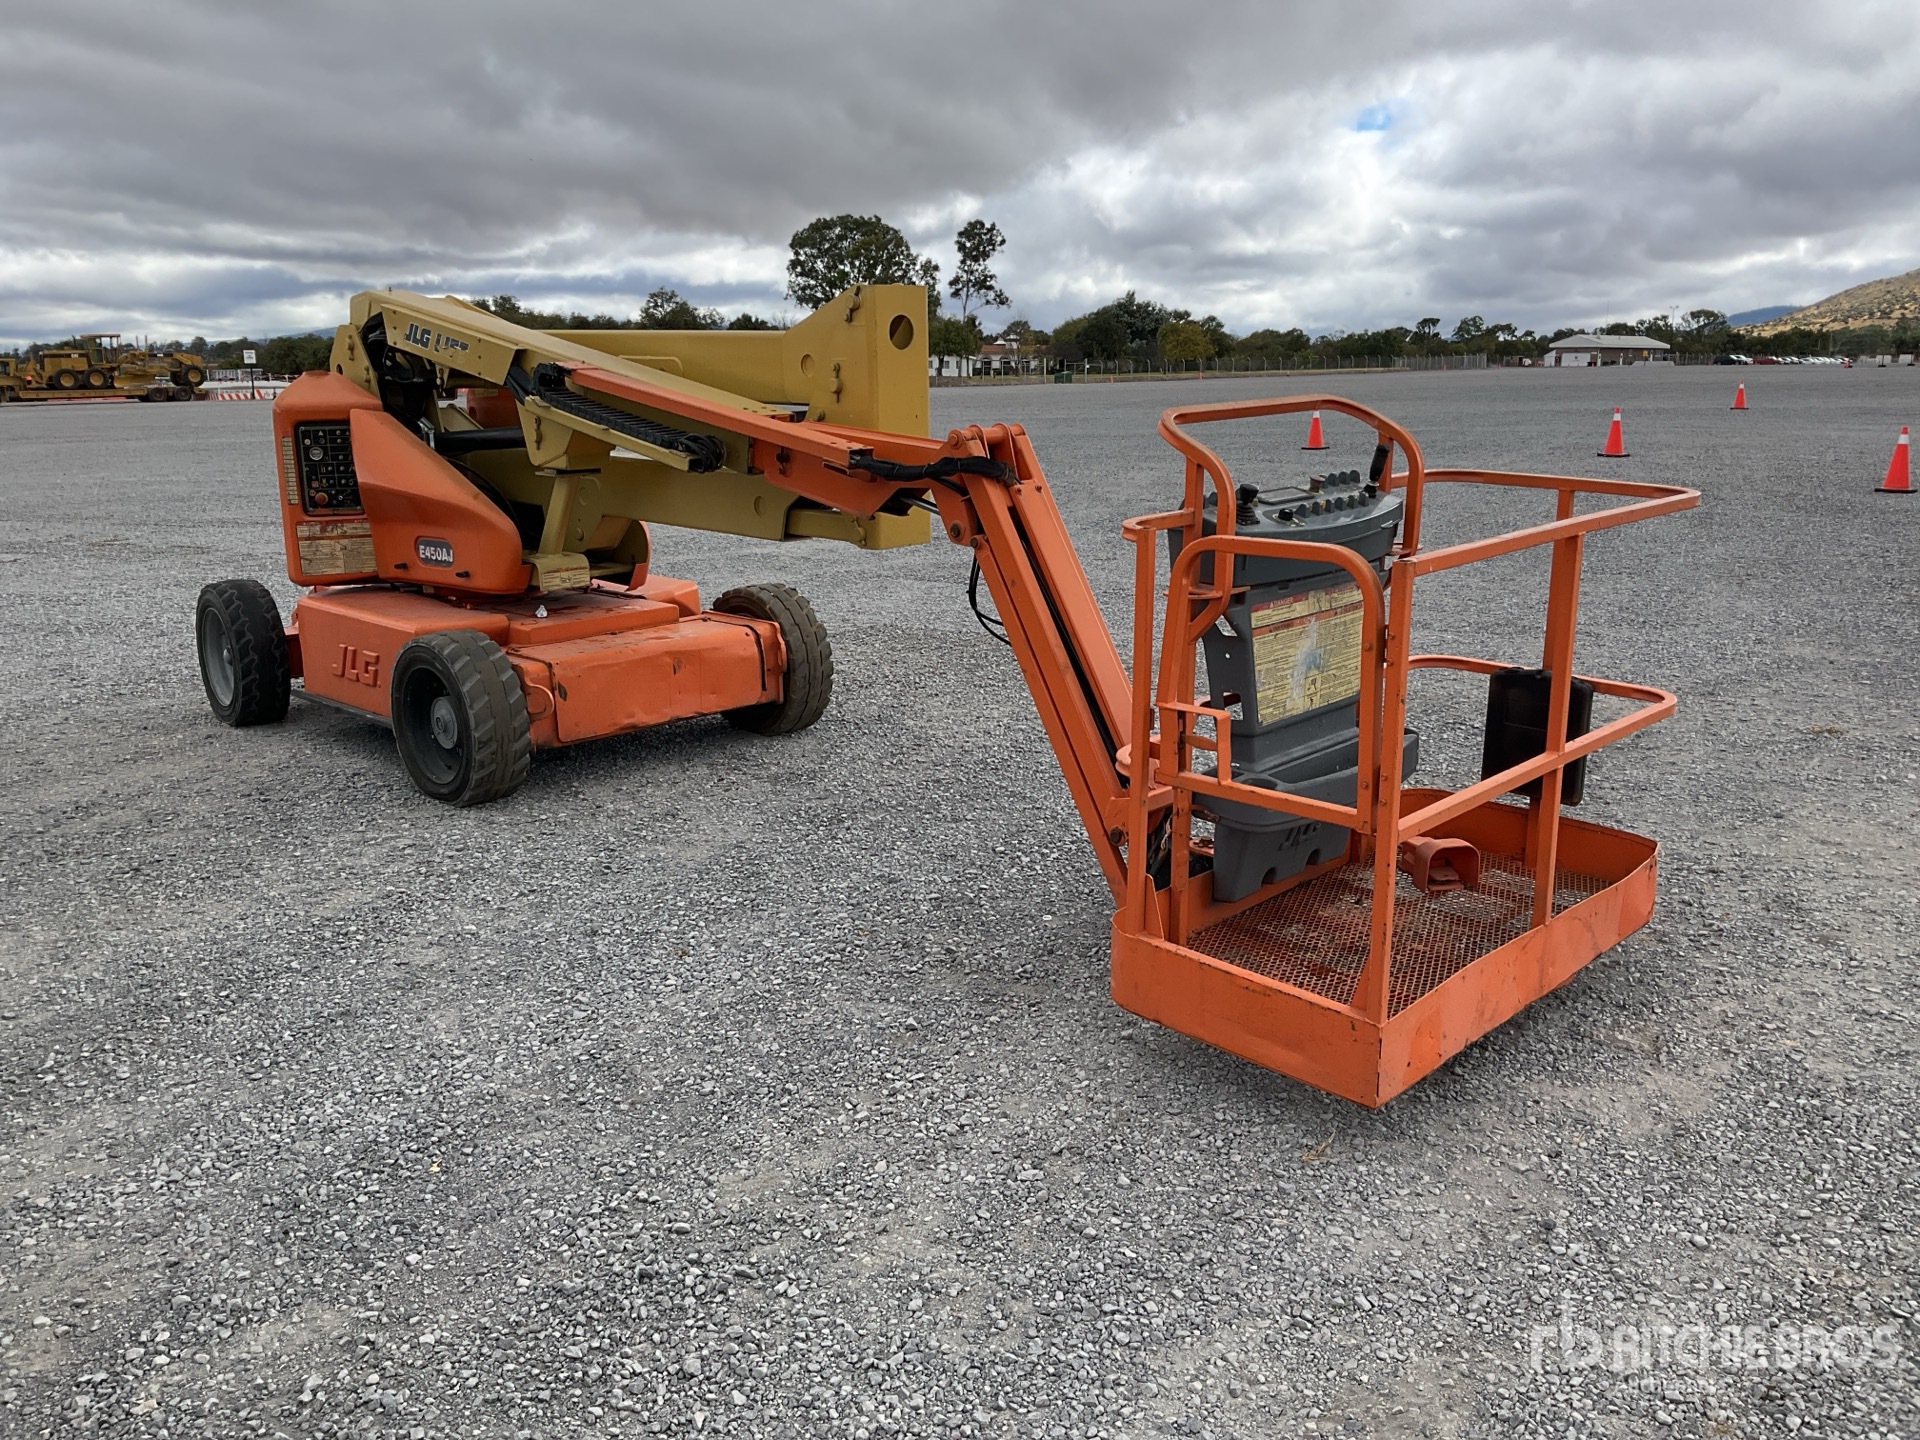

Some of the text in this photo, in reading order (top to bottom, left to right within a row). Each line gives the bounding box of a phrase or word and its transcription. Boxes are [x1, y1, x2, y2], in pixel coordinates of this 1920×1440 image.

[404, 323, 431, 349] JLG
[419, 545, 453, 562] E450AJ
[331, 644, 380, 688] JLG
